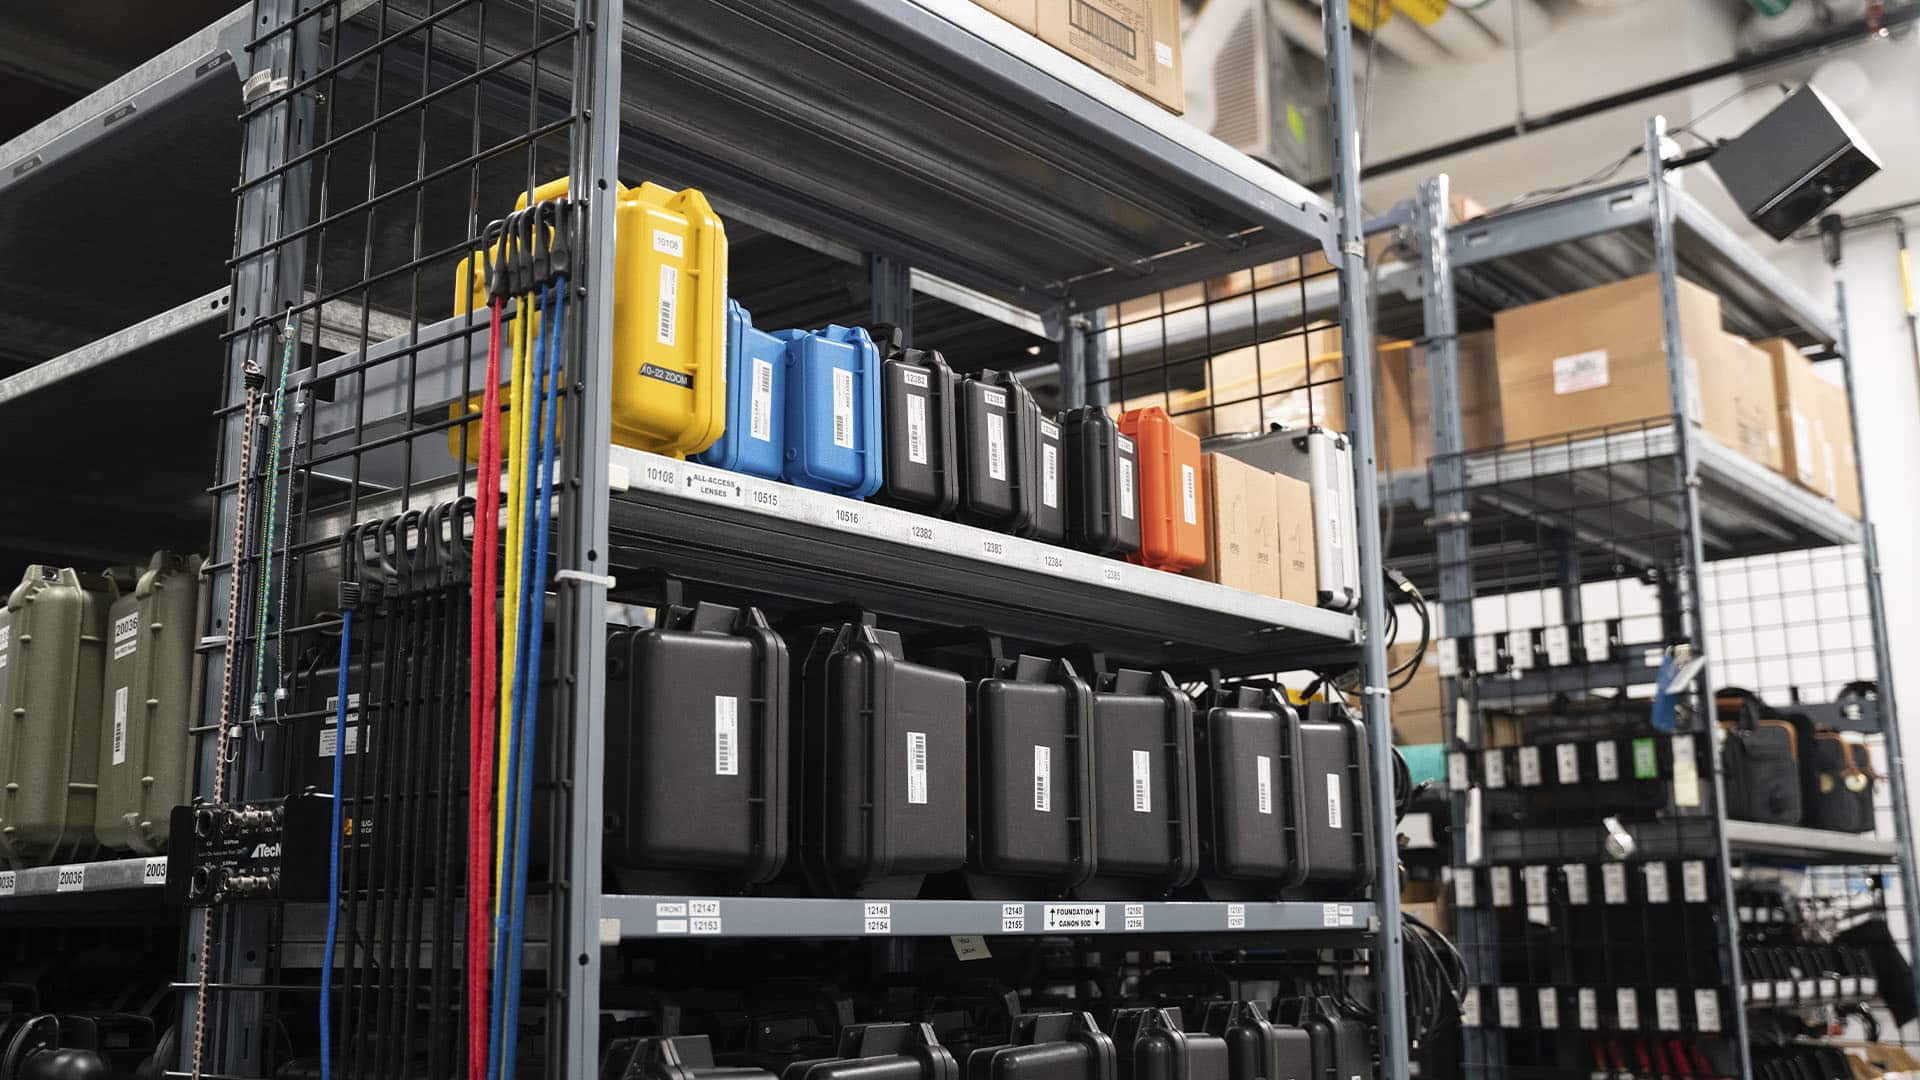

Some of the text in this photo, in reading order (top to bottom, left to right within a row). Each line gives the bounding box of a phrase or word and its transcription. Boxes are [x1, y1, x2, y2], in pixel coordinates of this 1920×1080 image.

[665, 371, 688, 384] ZOOM
[906, 372, 925, 385] 12382
[647, 467, 674, 484] 10108
[693, 474, 735, 488] ALL-ACCESS
[700, 487, 727, 497] LENSES
[752, 490, 778, 506] 10515
[836, 509, 859, 524] 10516
[911, 526, 932, 540] 12382
[983, 541, 1002, 555] 12383
[1044, 556, 1062, 568] 12384
[116, 617, 138, 637] 20036
[60, 871, 83, 885] 20036
[660, 905, 682, 913] FRONT
[692, 904, 717, 913] 12147
[1056, 908, 1094, 916] FOUNDATION
[694, 920, 718, 930] 12153
[868, 921, 888, 930] 12154
[1004, 920, 1023, 929] 12155
[1058, 920, 1080, 928] CANON
